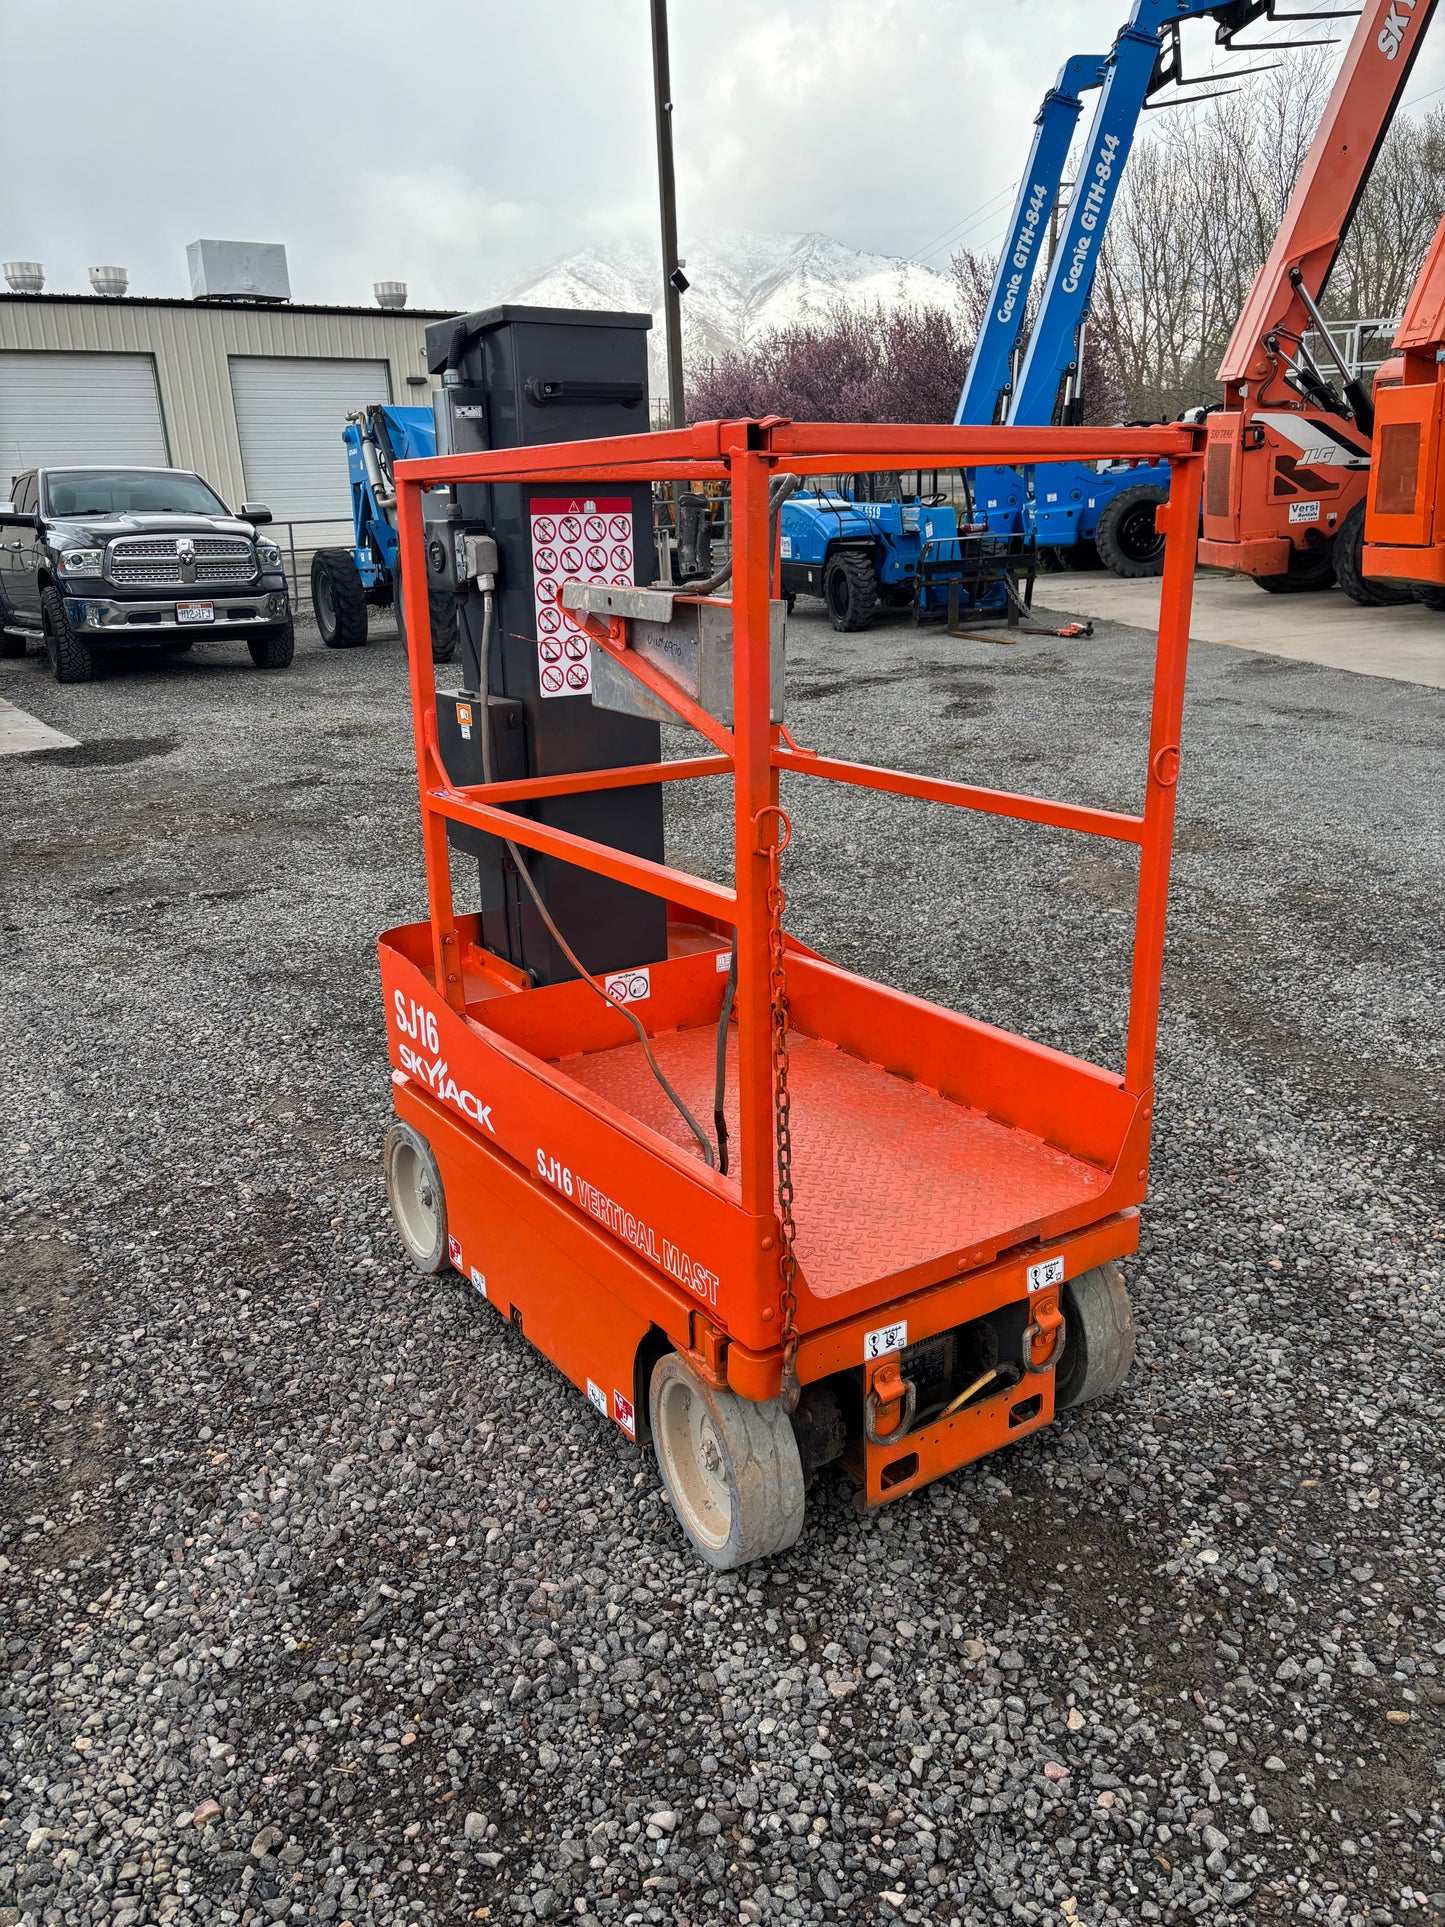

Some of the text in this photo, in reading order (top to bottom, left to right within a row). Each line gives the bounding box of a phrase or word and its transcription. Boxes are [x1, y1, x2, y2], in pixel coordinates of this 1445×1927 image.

[997, 183, 1048, 323] Genie GTH-844
[1061, 133, 1121, 293] Genie GTH-844
[1295, 446, 1336, 466] JLG
[1291, 502, 1319, 513] Versi
[663, 640, 682, 657] 6970
[393, 988, 441, 1056] SJ16
[399, 1042, 497, 1135] SKYJACK
[536, 1147, 720, 1307] SJ16 VERTICAL MAST
